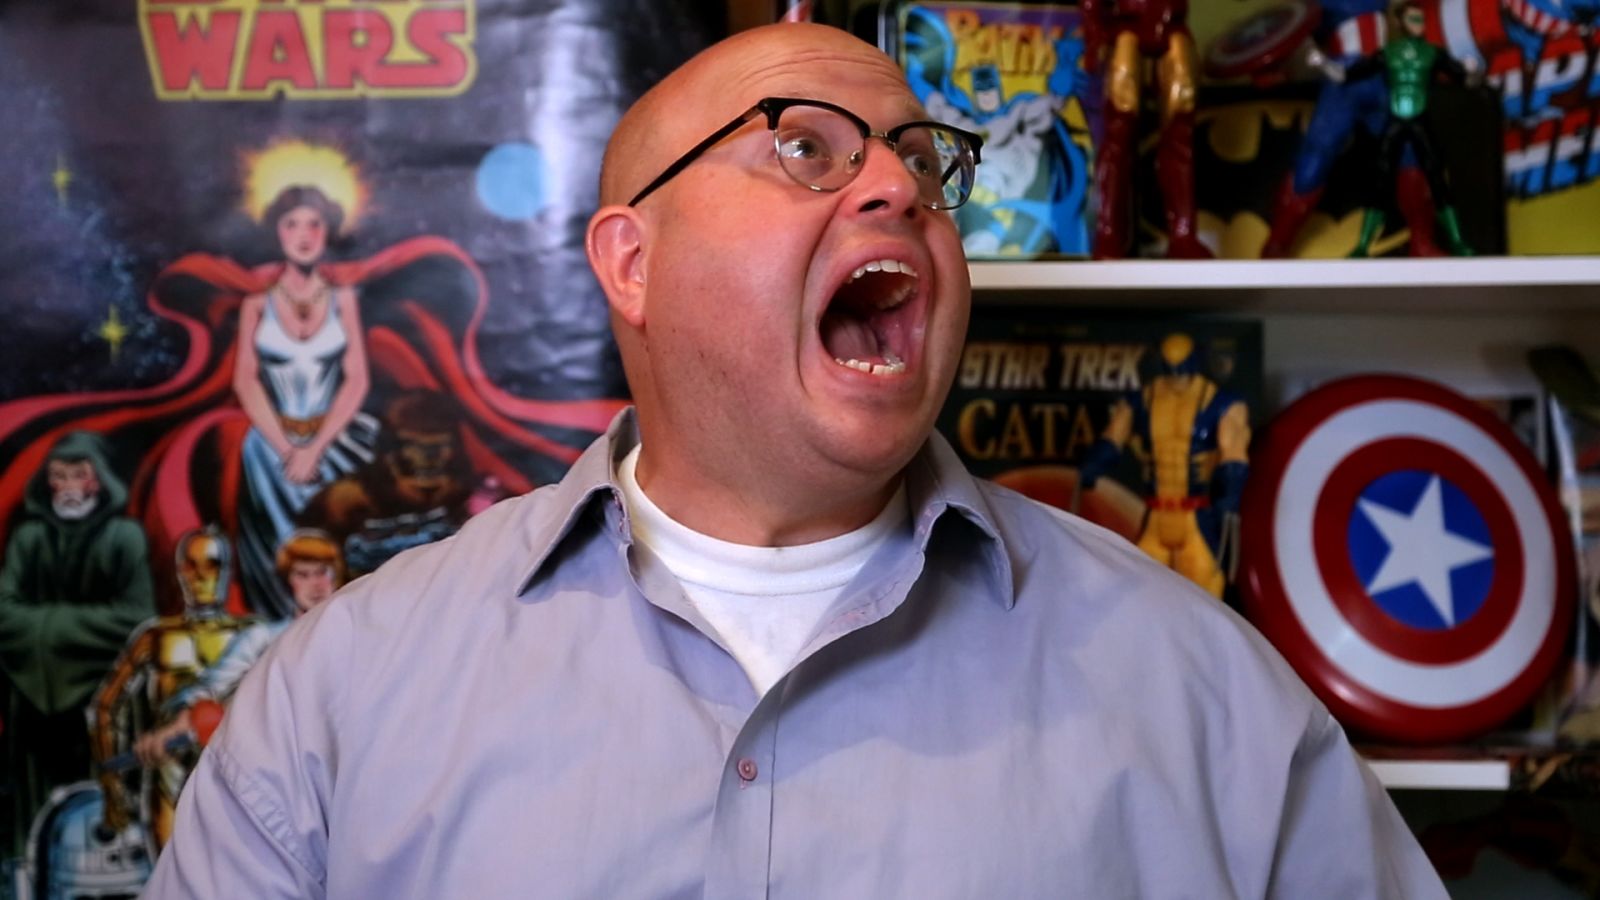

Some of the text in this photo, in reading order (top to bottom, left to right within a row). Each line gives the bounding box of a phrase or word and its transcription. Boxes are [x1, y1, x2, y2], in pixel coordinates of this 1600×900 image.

[147, 8, 470, 95] WARS
[944, 9, 1064, 76] BATM
[958, 341, 1147, 392] STAR TREK
